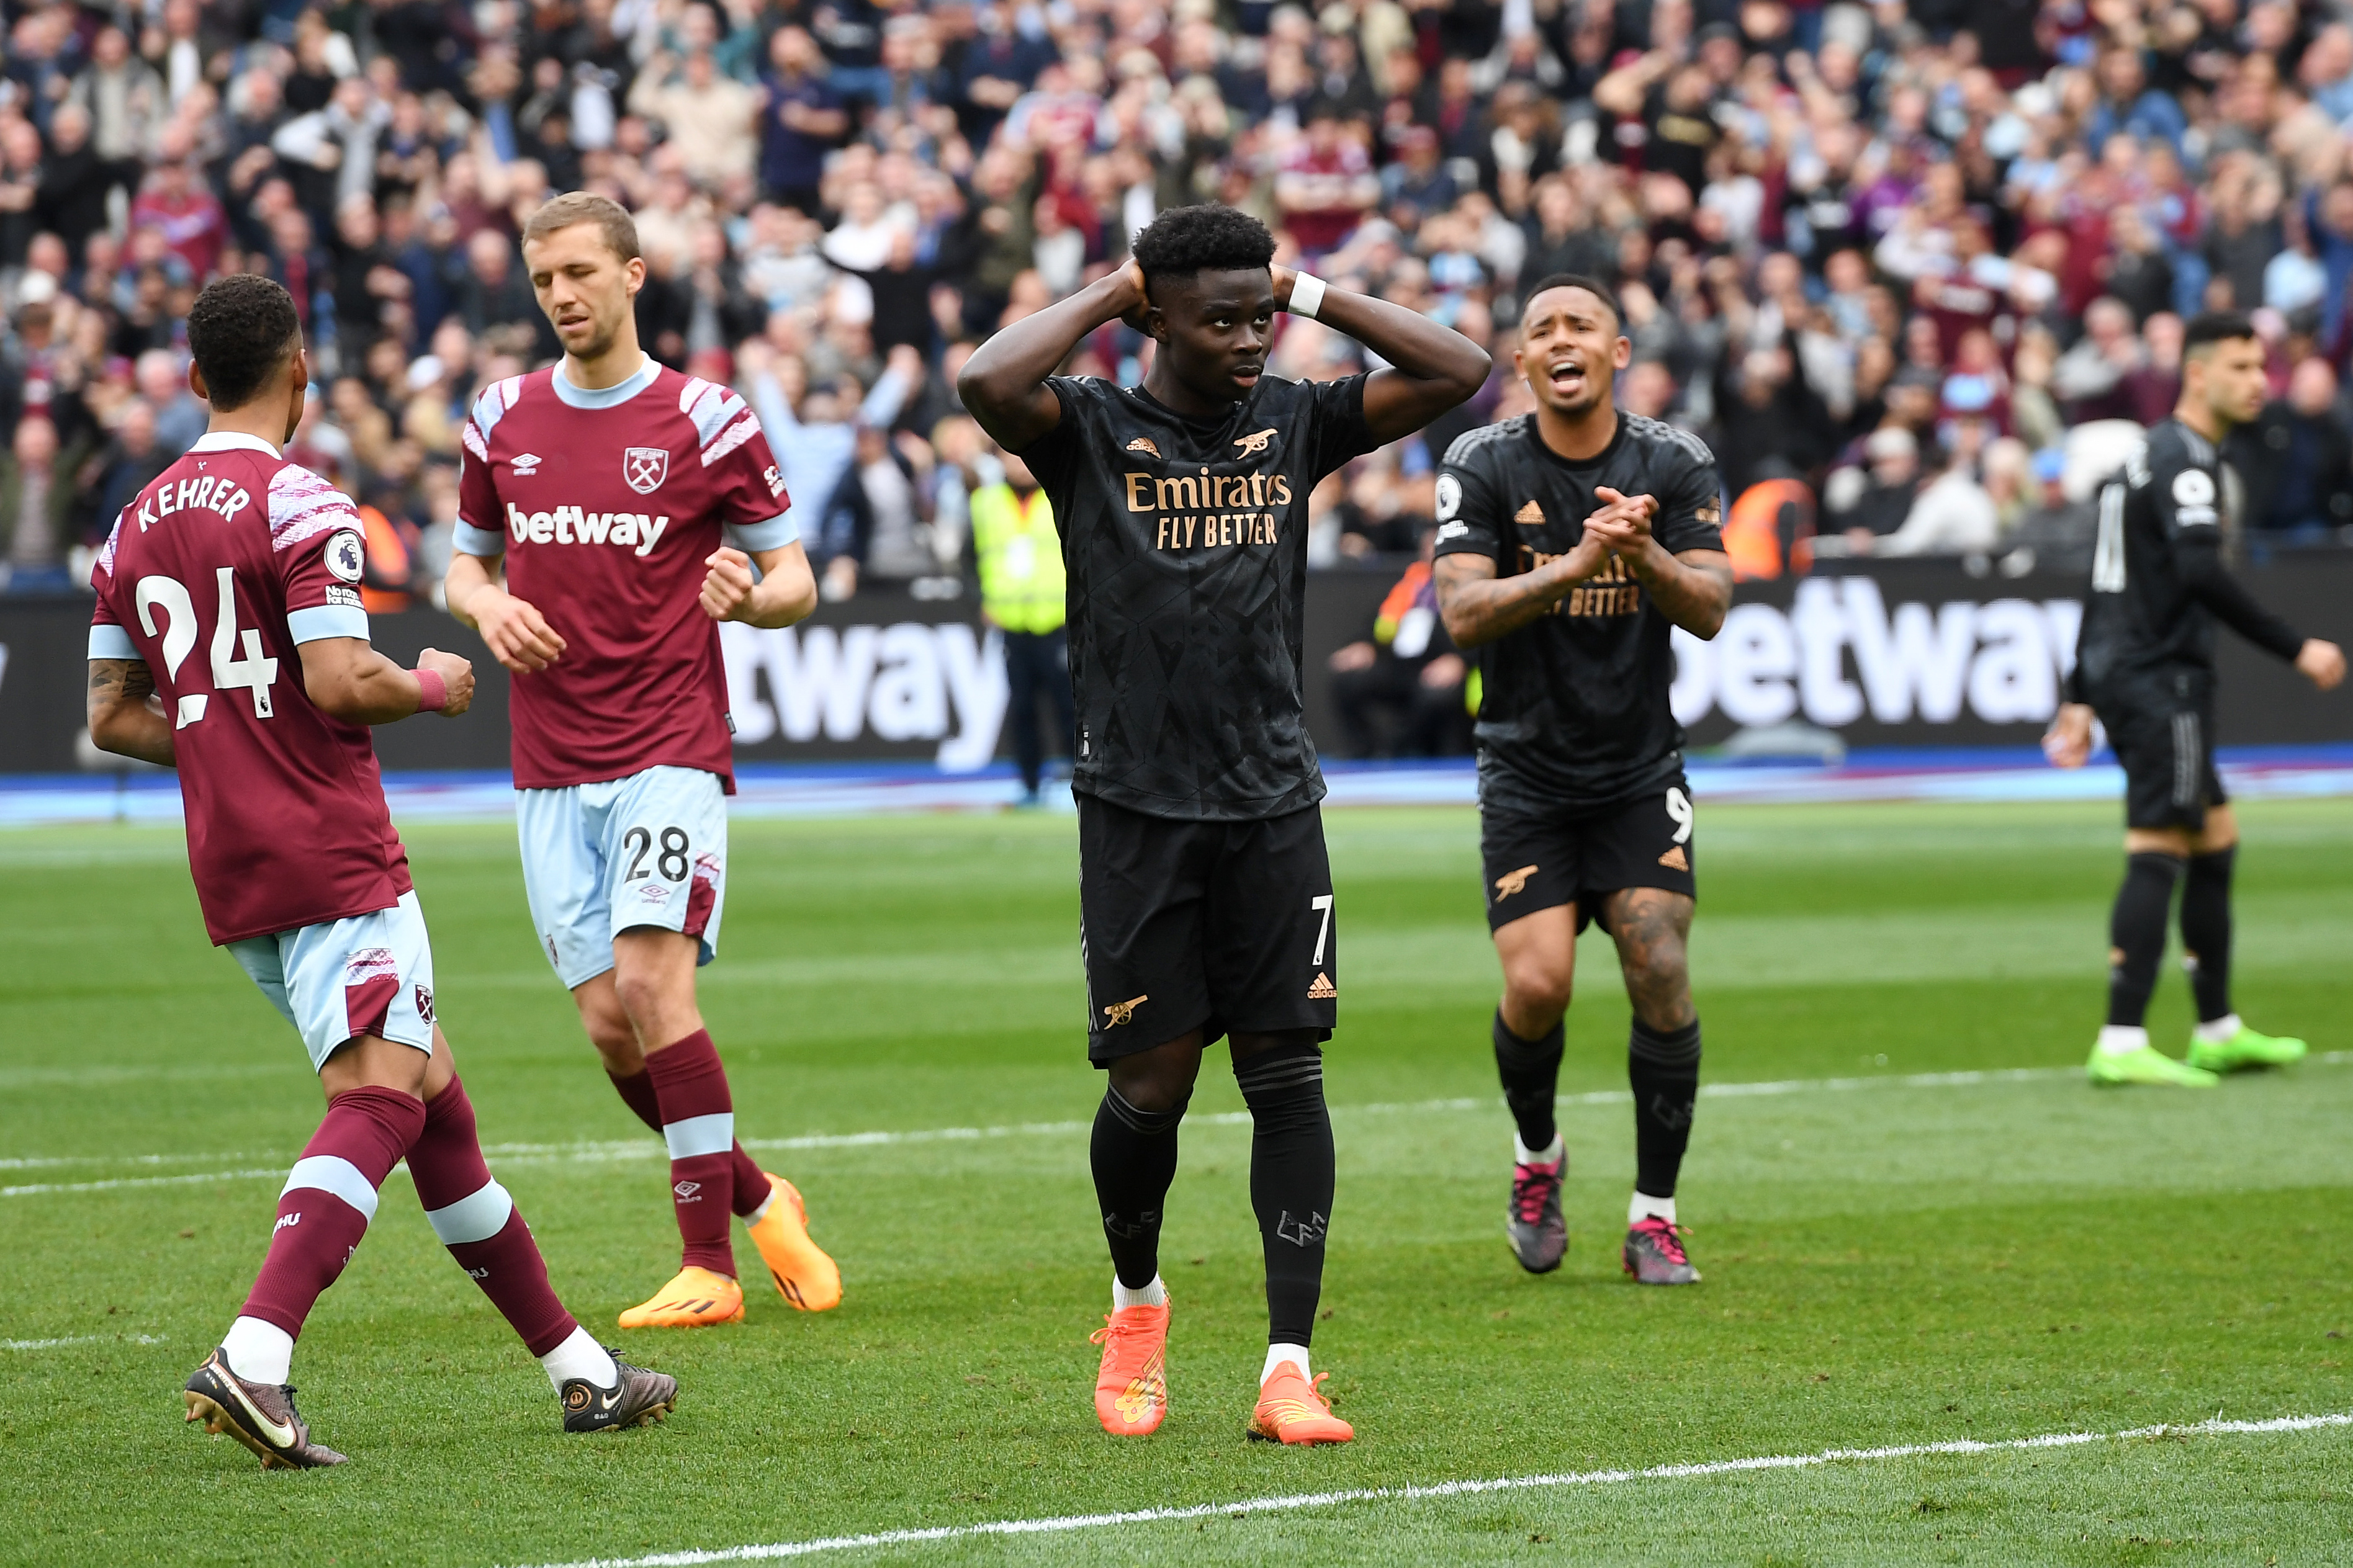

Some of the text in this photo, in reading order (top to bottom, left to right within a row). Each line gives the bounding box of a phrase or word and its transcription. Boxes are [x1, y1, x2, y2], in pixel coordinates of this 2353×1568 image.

[1126, 443, 1162, 459] adidas
[138, 475, 250, 533] KEHRER
[1124, 467, 1292, 513] Emirates
[506, 501, 669, 557] betway
[1157, 513, 1278, 550] FLY BETTER
[135, 567, 278, 730] 24
[718, 620, 1011, 774] tway
[1665, 787, 1693, 844] 9
[624, 826, 690, 884] 28
[1311, 894, 1333, 965] 7
[1307, 989, 1338, 1000] adidas
